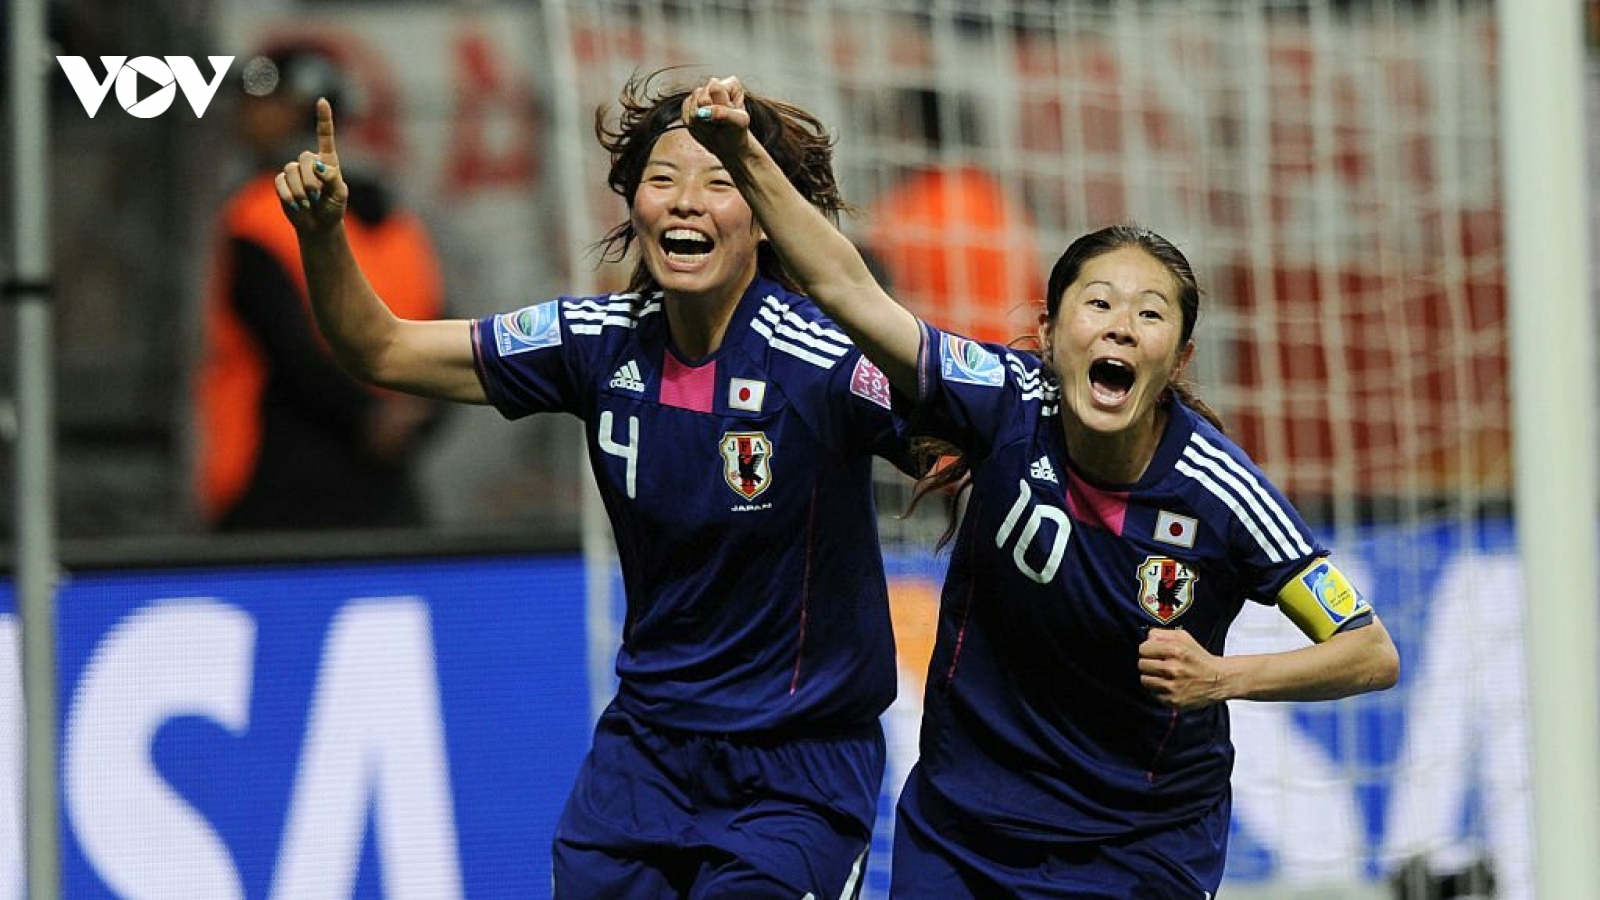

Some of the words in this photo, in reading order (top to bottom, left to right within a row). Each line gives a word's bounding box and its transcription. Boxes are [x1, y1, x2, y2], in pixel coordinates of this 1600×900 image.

[609, 379, 645, 393] adidas
[598, 410, 640, 500] 4
[731, 502, 773, 512] JAPAN
[995, 478, 1072, 584] 10
